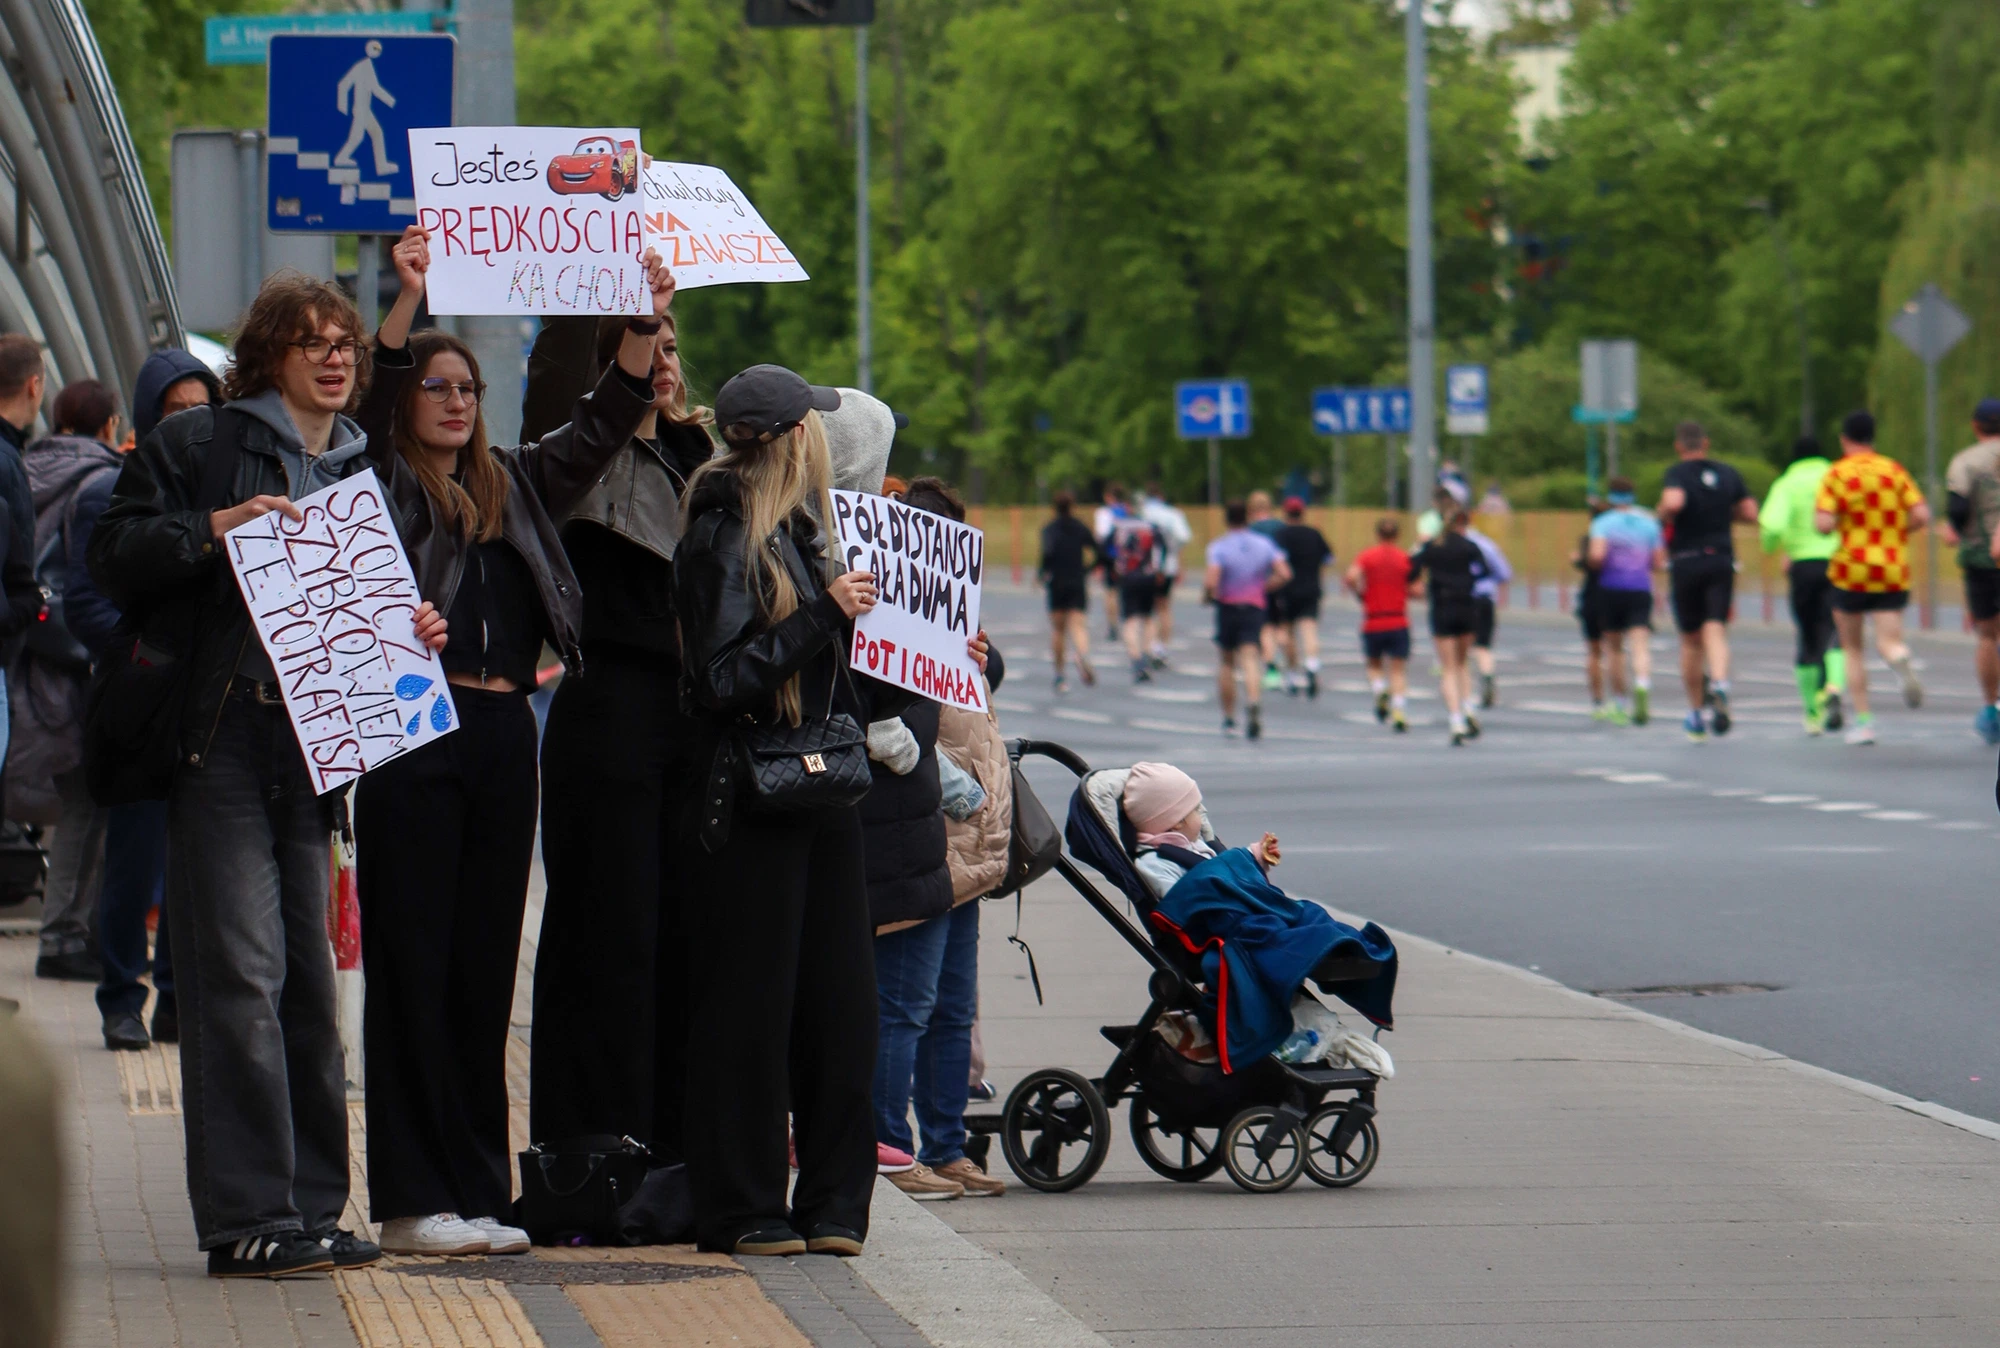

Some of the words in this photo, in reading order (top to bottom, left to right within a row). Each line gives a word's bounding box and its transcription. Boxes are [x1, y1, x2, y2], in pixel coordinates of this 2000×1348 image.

[431, 142, 539, 187] Jesteś
[643, 169, 746, 218] chwilowy
[419, 199, 644, 268] PRĘDKOŚCIĄ
[660, 232, 797, 267] ZAWSZE
[507, 260, 547, 309] KA
[555, 264, 645, 313] CHOW
[232, 514, 297, 603] ŻE
[835, 493, 888, 550] PÓŁ
[888, 503, 982, 586] DYSTANSU
[326, 490, 431, 672] SKOŃCZ
[910, 562, 968, 637] DUMA
[279, 505, 377, 655] SZYBKO
[339, 655, 408, 769] WIEM
[854, 629, 896, 676] POT
[900, 648, 907, 684] I
[912, 652, 982, 708] CHWAŁA
[260, 593, 366, 790] POTRAFISZ
